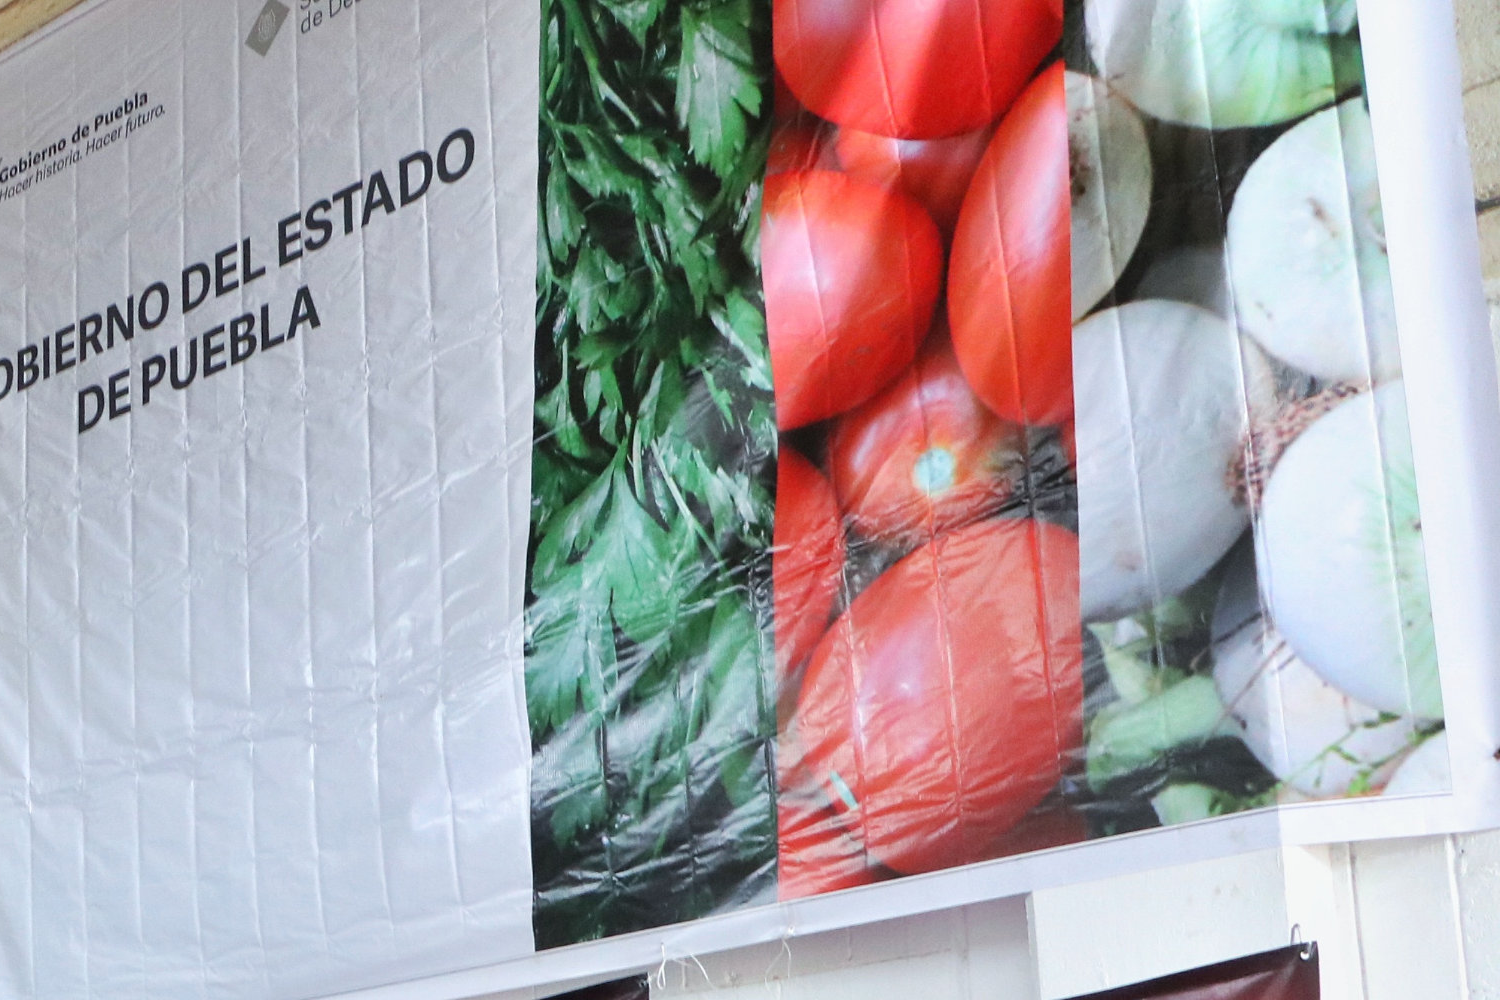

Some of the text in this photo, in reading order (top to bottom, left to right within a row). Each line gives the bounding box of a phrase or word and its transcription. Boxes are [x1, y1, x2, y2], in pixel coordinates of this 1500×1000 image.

[300, 7, 323, 34] de
[0, 92, 148, 183] Gobierno de Puebla
[0, 104, 165, 203] Hacer historia. Hacer futuro.
[182, 238, 265, 314] DEL
[278, 128, 475, 267] ESTADO
[78, 285, 321, 434] DE PUEBLA
